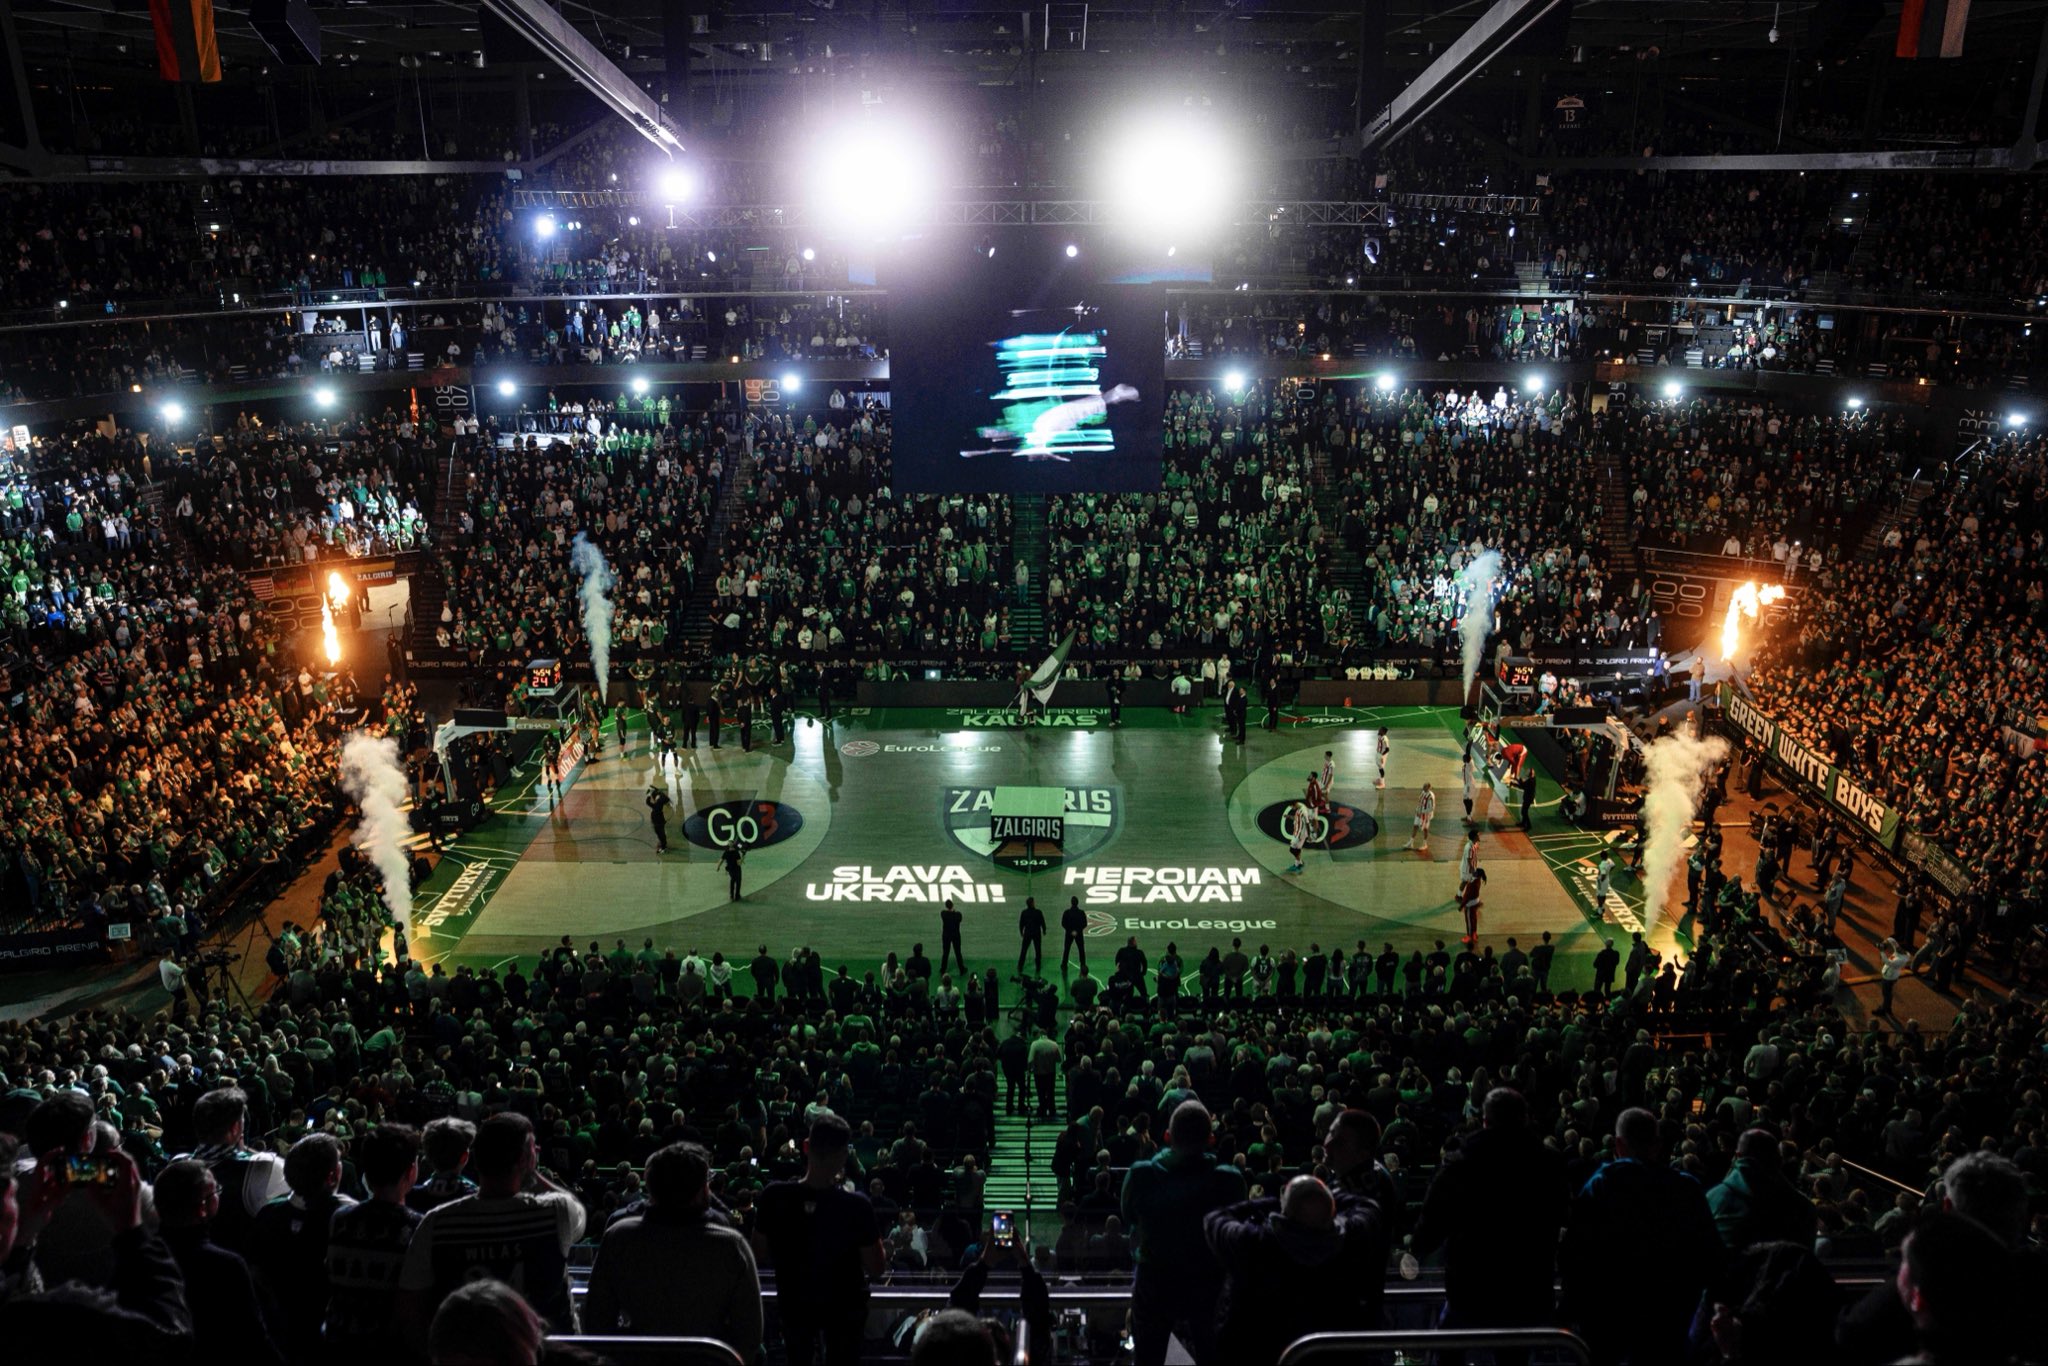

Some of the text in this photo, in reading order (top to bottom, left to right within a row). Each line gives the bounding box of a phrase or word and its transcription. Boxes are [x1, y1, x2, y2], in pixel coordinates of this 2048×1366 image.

[1565, 110, 1576, 122] 13
[532, 676, 549, 688] 24
[1511, 674, 1530, 685] 24
[963, 715, 1099, 727] KAUNAS
[884, 744, 1002, 753] EuroLegue
[1729, 694, 1885, 835] GREEN WHITE BOYS
[1012, 859, 1049, 867] 1944
[832, 865, 974, 883] SLAVA
[1063, 866, 1261, 885] HEROIAM
[806, 883, 1006, 903] UKRAINI!
[1085, 885, 1243, 904] SLAVA!
[1124, 917, 1277, 933] EuroLeague
